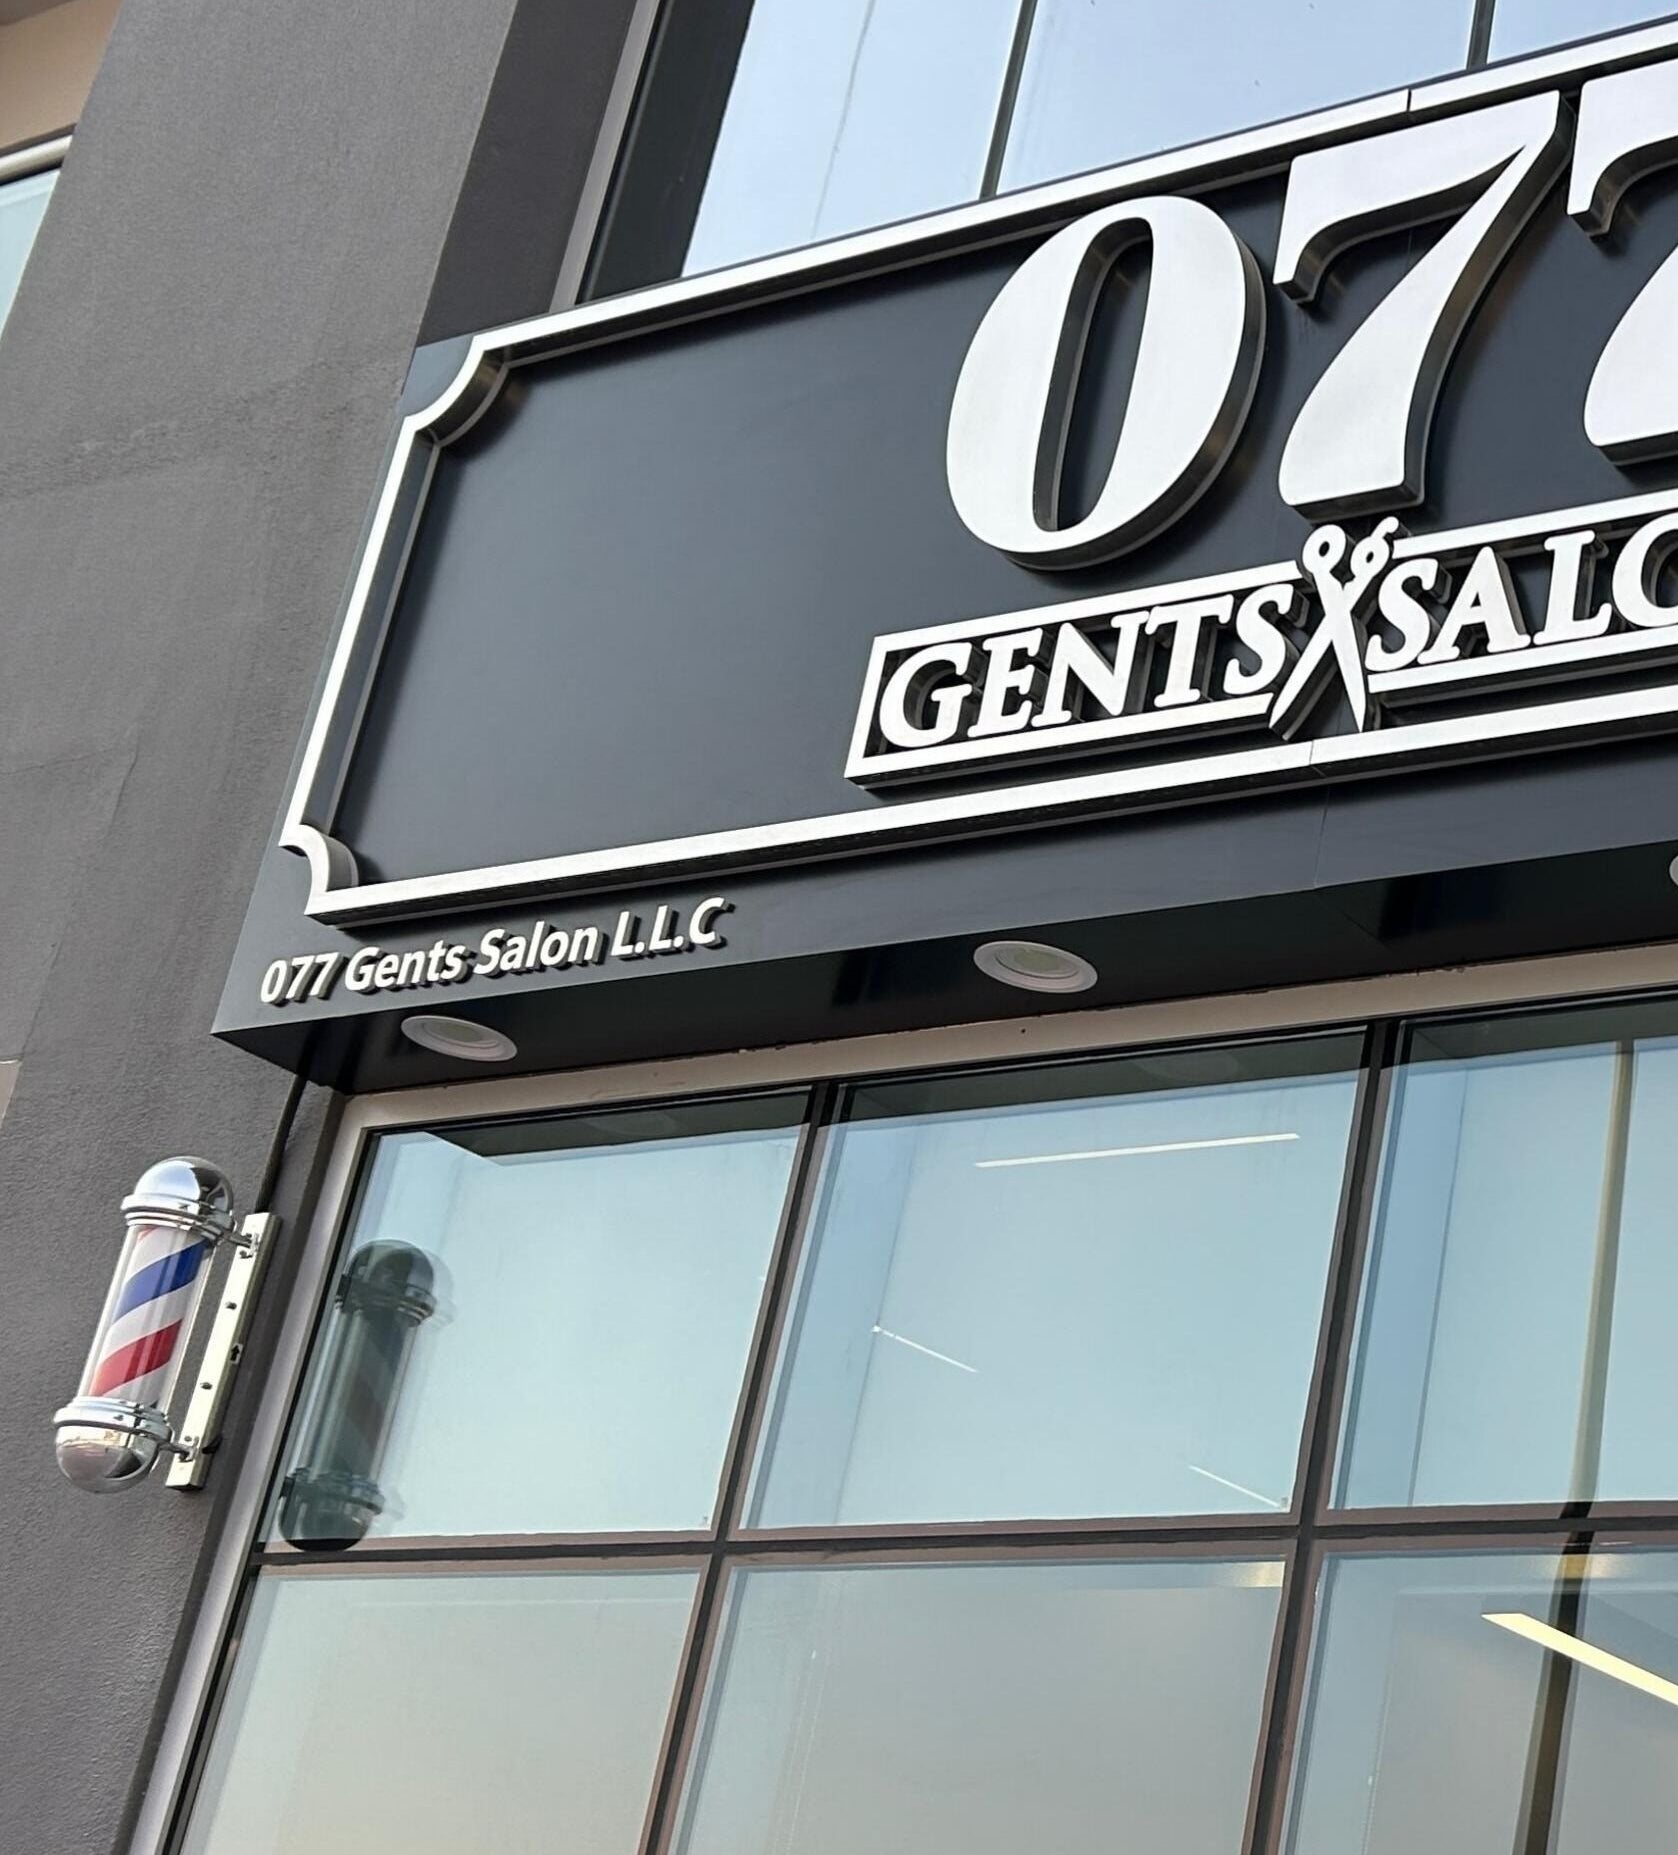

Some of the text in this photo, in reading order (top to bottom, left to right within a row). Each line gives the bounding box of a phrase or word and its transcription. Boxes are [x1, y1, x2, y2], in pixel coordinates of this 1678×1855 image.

[879, 580, 1294, 748] GENTS
[260, 952, 338, 1003] 077
[344, 944, 463, 992] Gents
[473, 920, 600, 976] Salon
